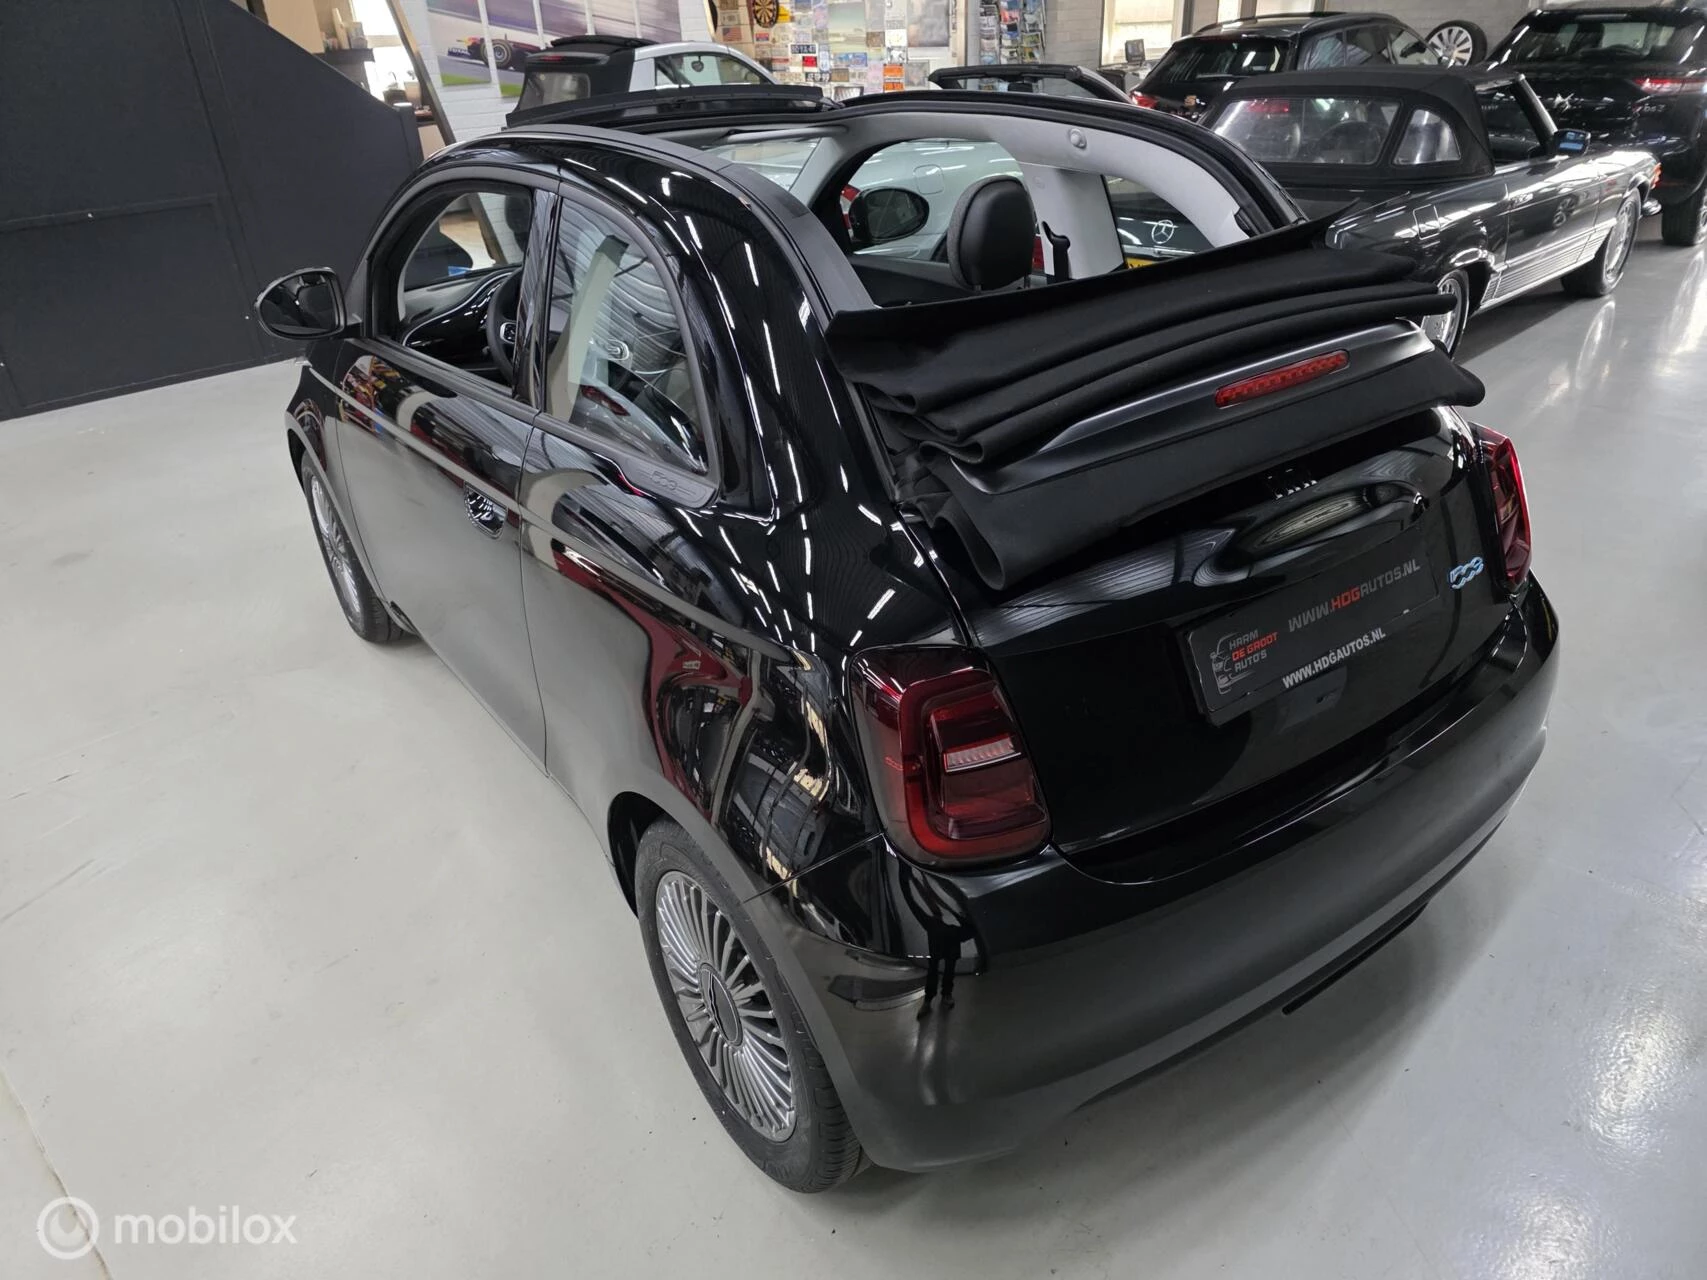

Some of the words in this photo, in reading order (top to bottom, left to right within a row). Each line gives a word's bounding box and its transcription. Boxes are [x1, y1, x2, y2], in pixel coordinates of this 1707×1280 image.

[650, 470, 678, 491] 500
[1449, 556, 1485, 590] 500
[1288, 558, 1421, 633] WWW.HDGAUTOS.NL
[1229, 629, 1259, 650] HARM
[1231, 647, 1246, 661] DE
[1246, 631, 1279, 655] GROOT
[1282, 627, 1387, 689] WWW.HDGAUTOS.NL
